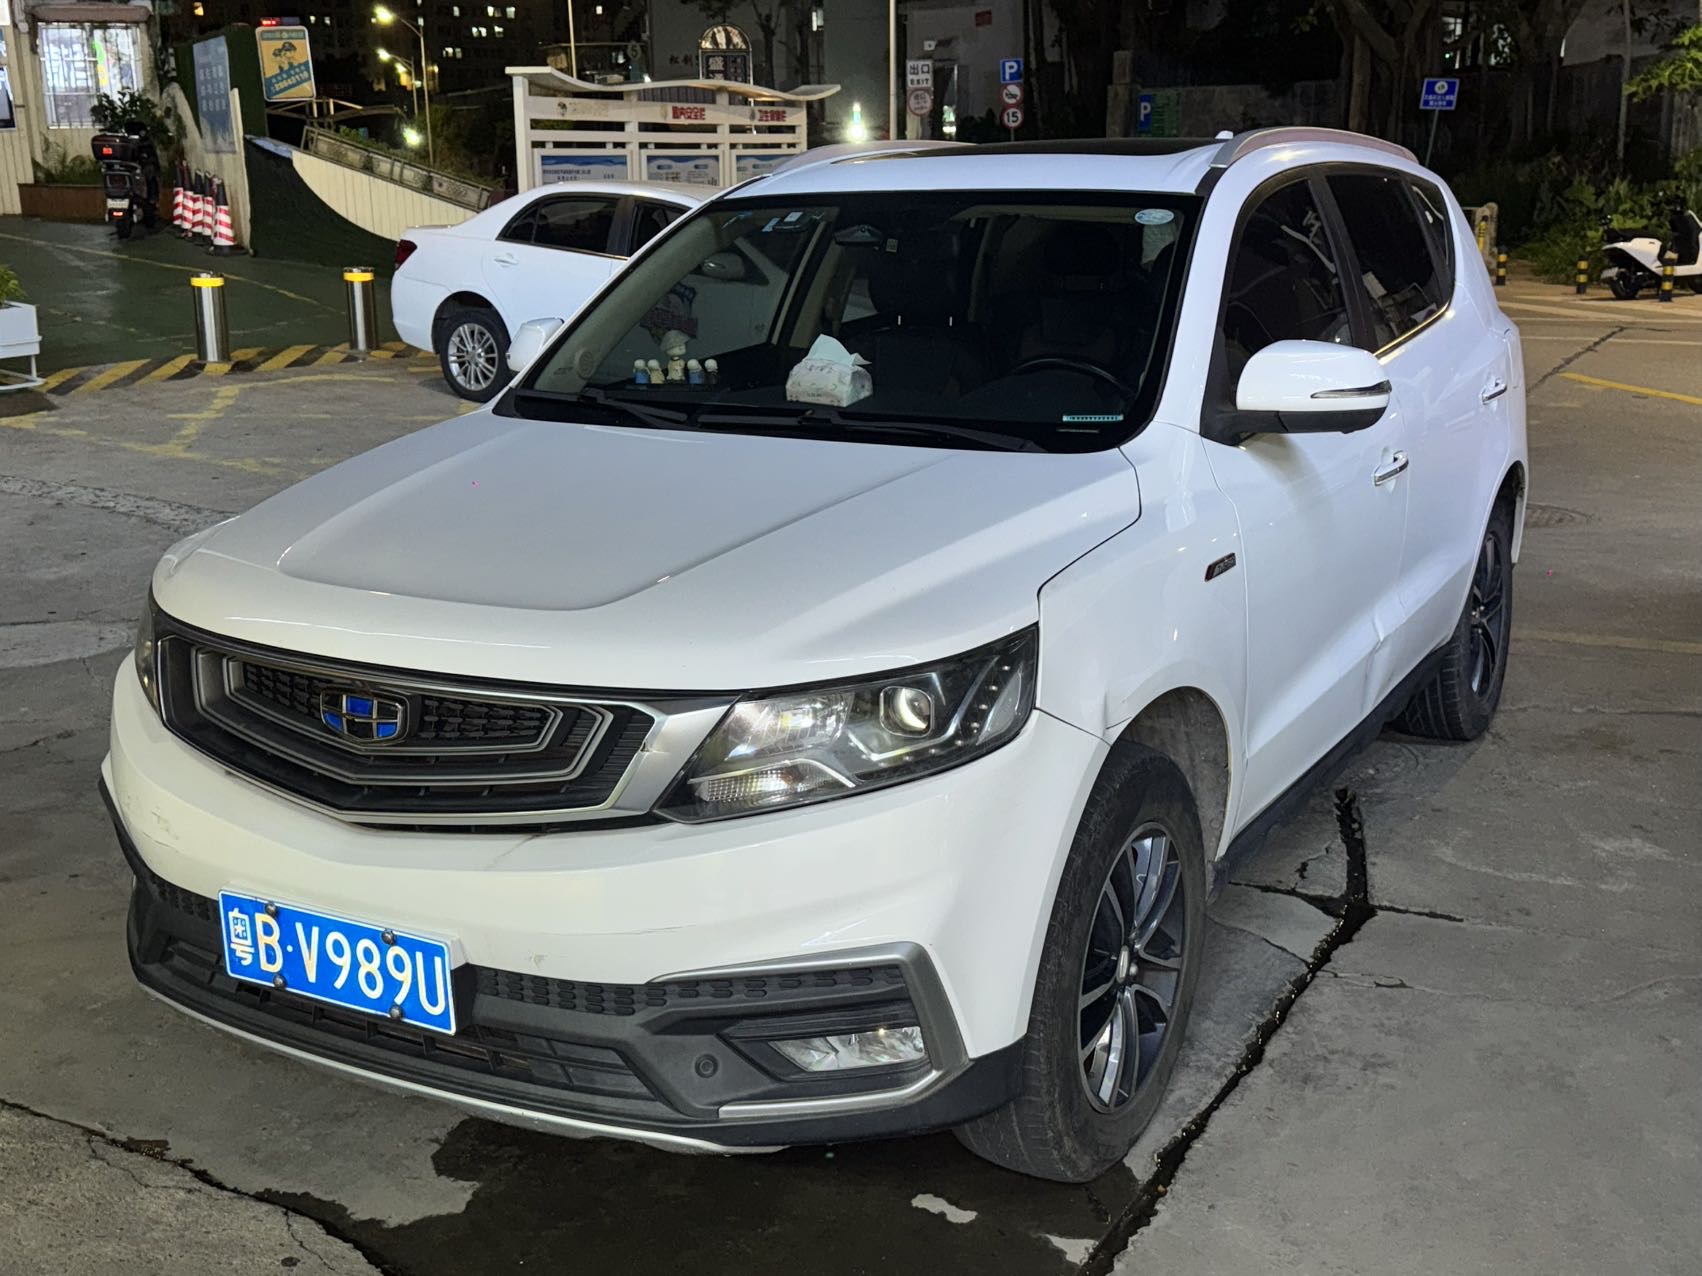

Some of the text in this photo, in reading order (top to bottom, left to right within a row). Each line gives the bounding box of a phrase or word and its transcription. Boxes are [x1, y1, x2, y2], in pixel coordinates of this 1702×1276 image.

[909, 63, 930, 75] 出口
[1005, 61, 1018, 80] P
[1006, 111, 1019, 123] 15
[1140, 101, 1151, 121] P
[228, 907, 446, 1016] 粤B·V989U
